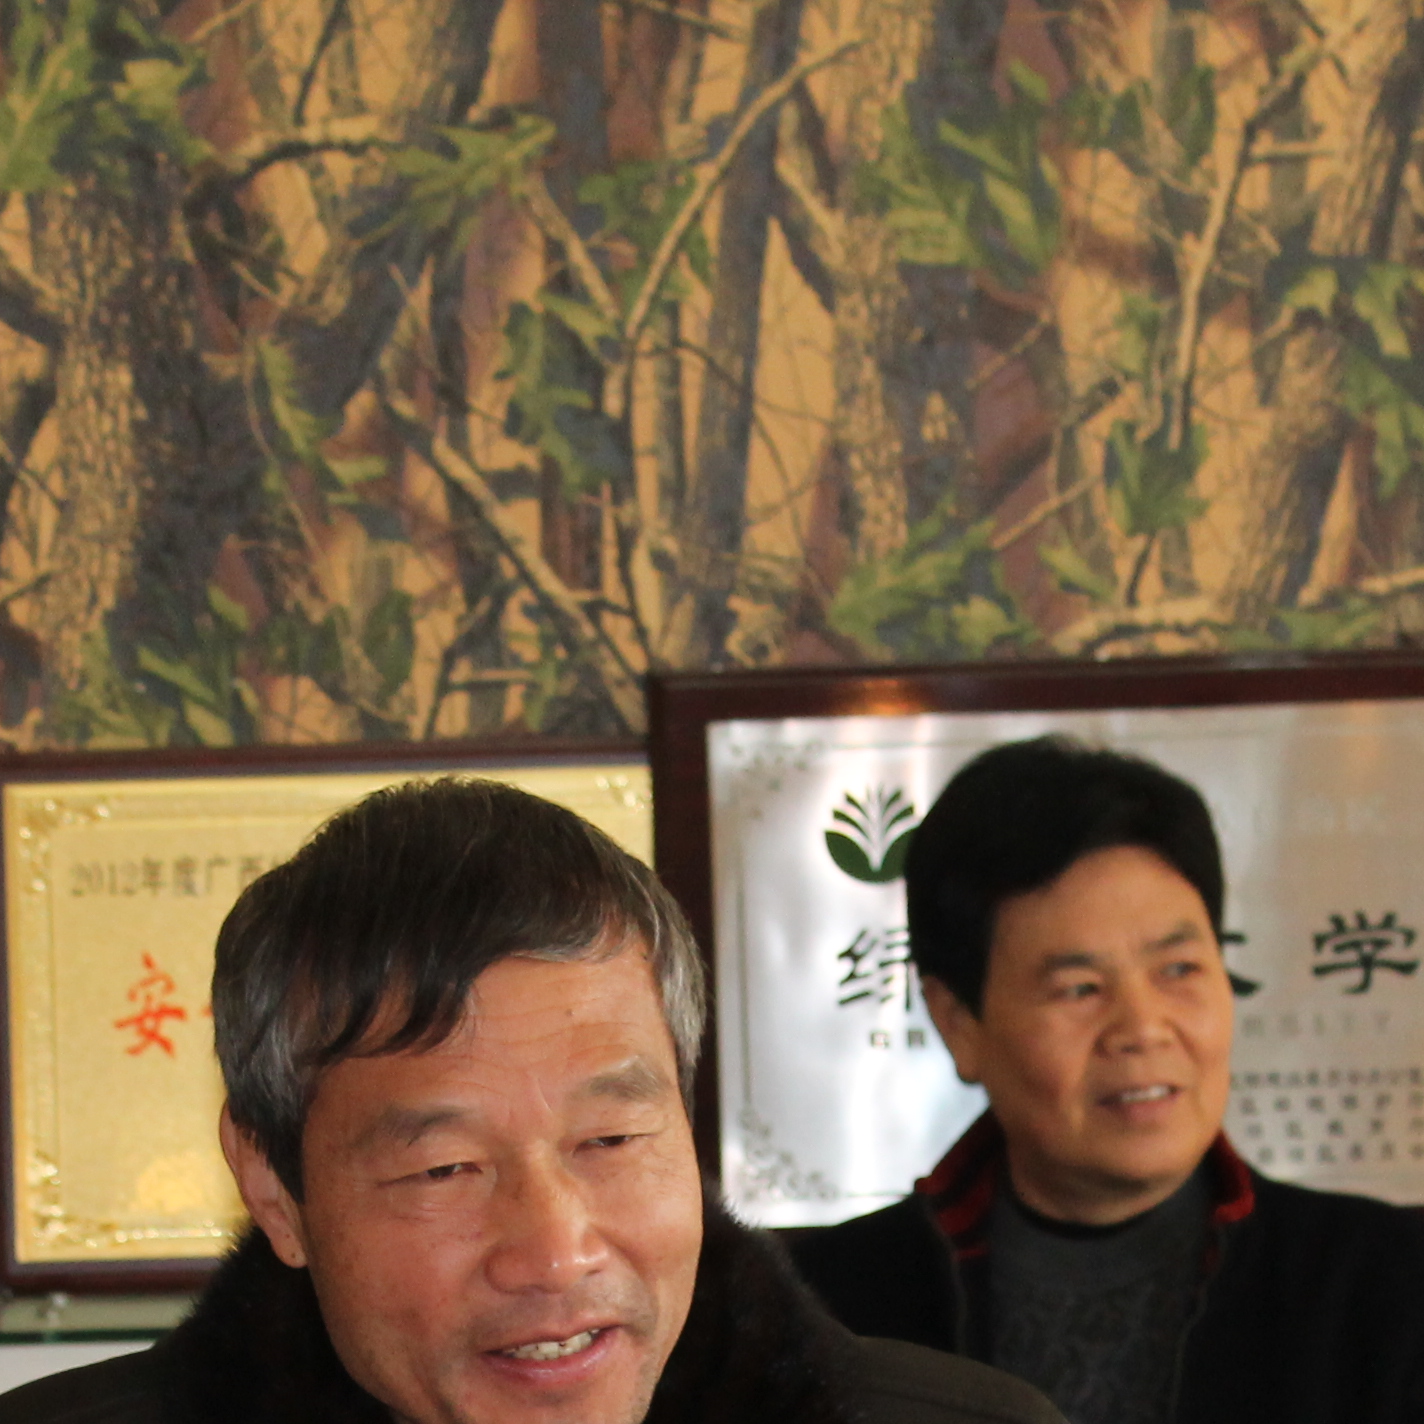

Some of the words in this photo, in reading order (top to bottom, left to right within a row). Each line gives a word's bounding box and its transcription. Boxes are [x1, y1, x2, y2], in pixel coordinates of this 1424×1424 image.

[71, 855, 290, 898] 2012年度广西
[112, 948, 214, 1060] 安
